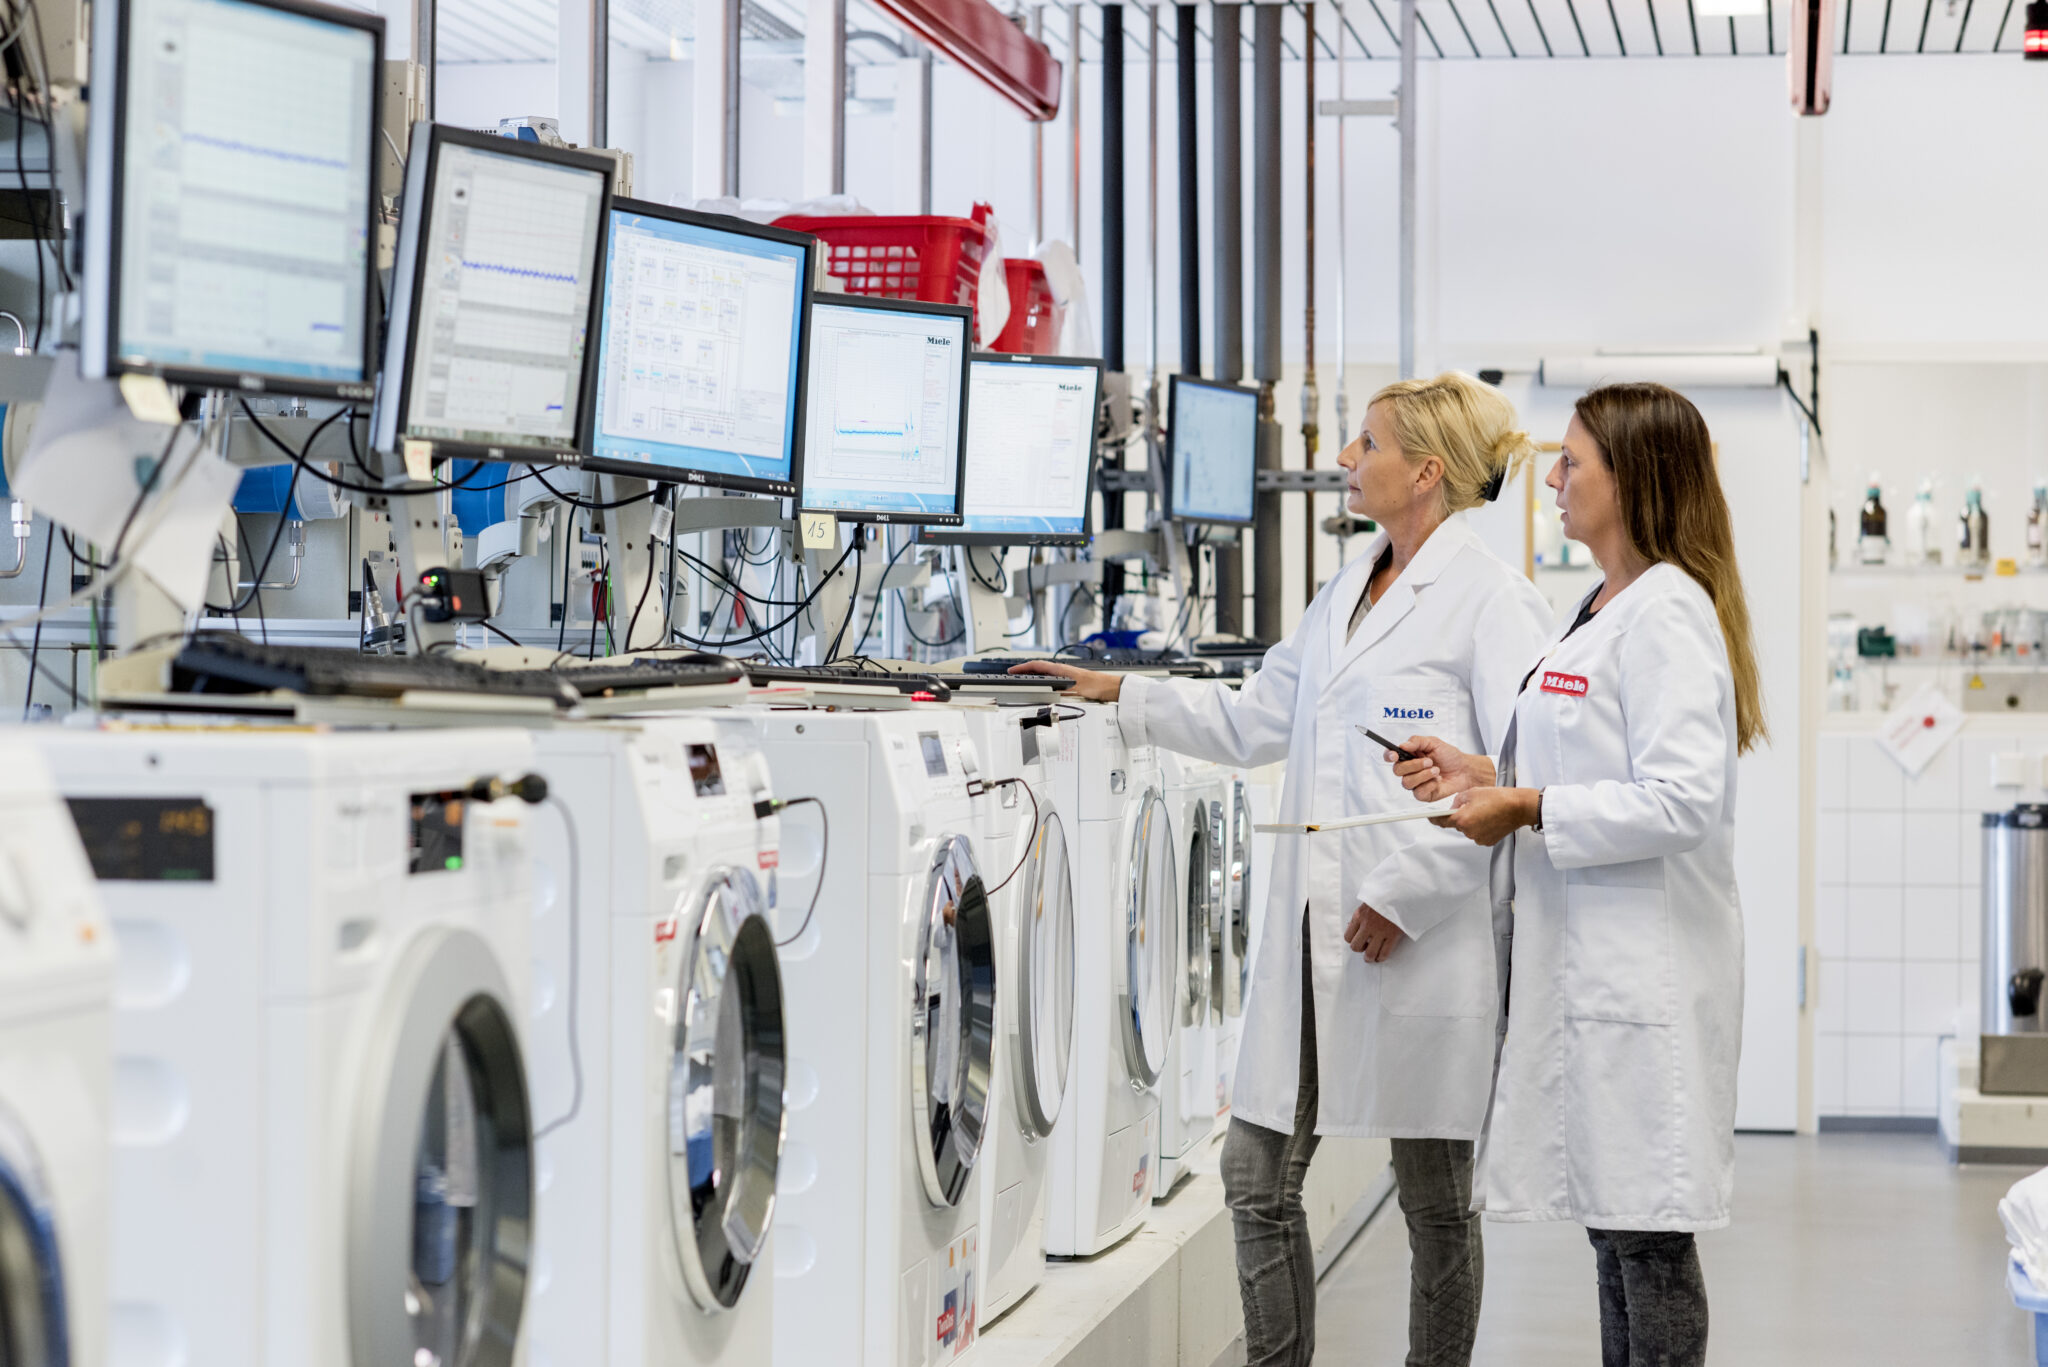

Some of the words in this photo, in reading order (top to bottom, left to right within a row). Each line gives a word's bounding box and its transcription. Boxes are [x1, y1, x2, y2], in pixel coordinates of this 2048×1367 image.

[927, 336, 951, 346] Miele
[807, 520, 826, 539] 15
[1544, 675, 1586, 693] Miele
[1383, 707, 1434, 719] Miele
